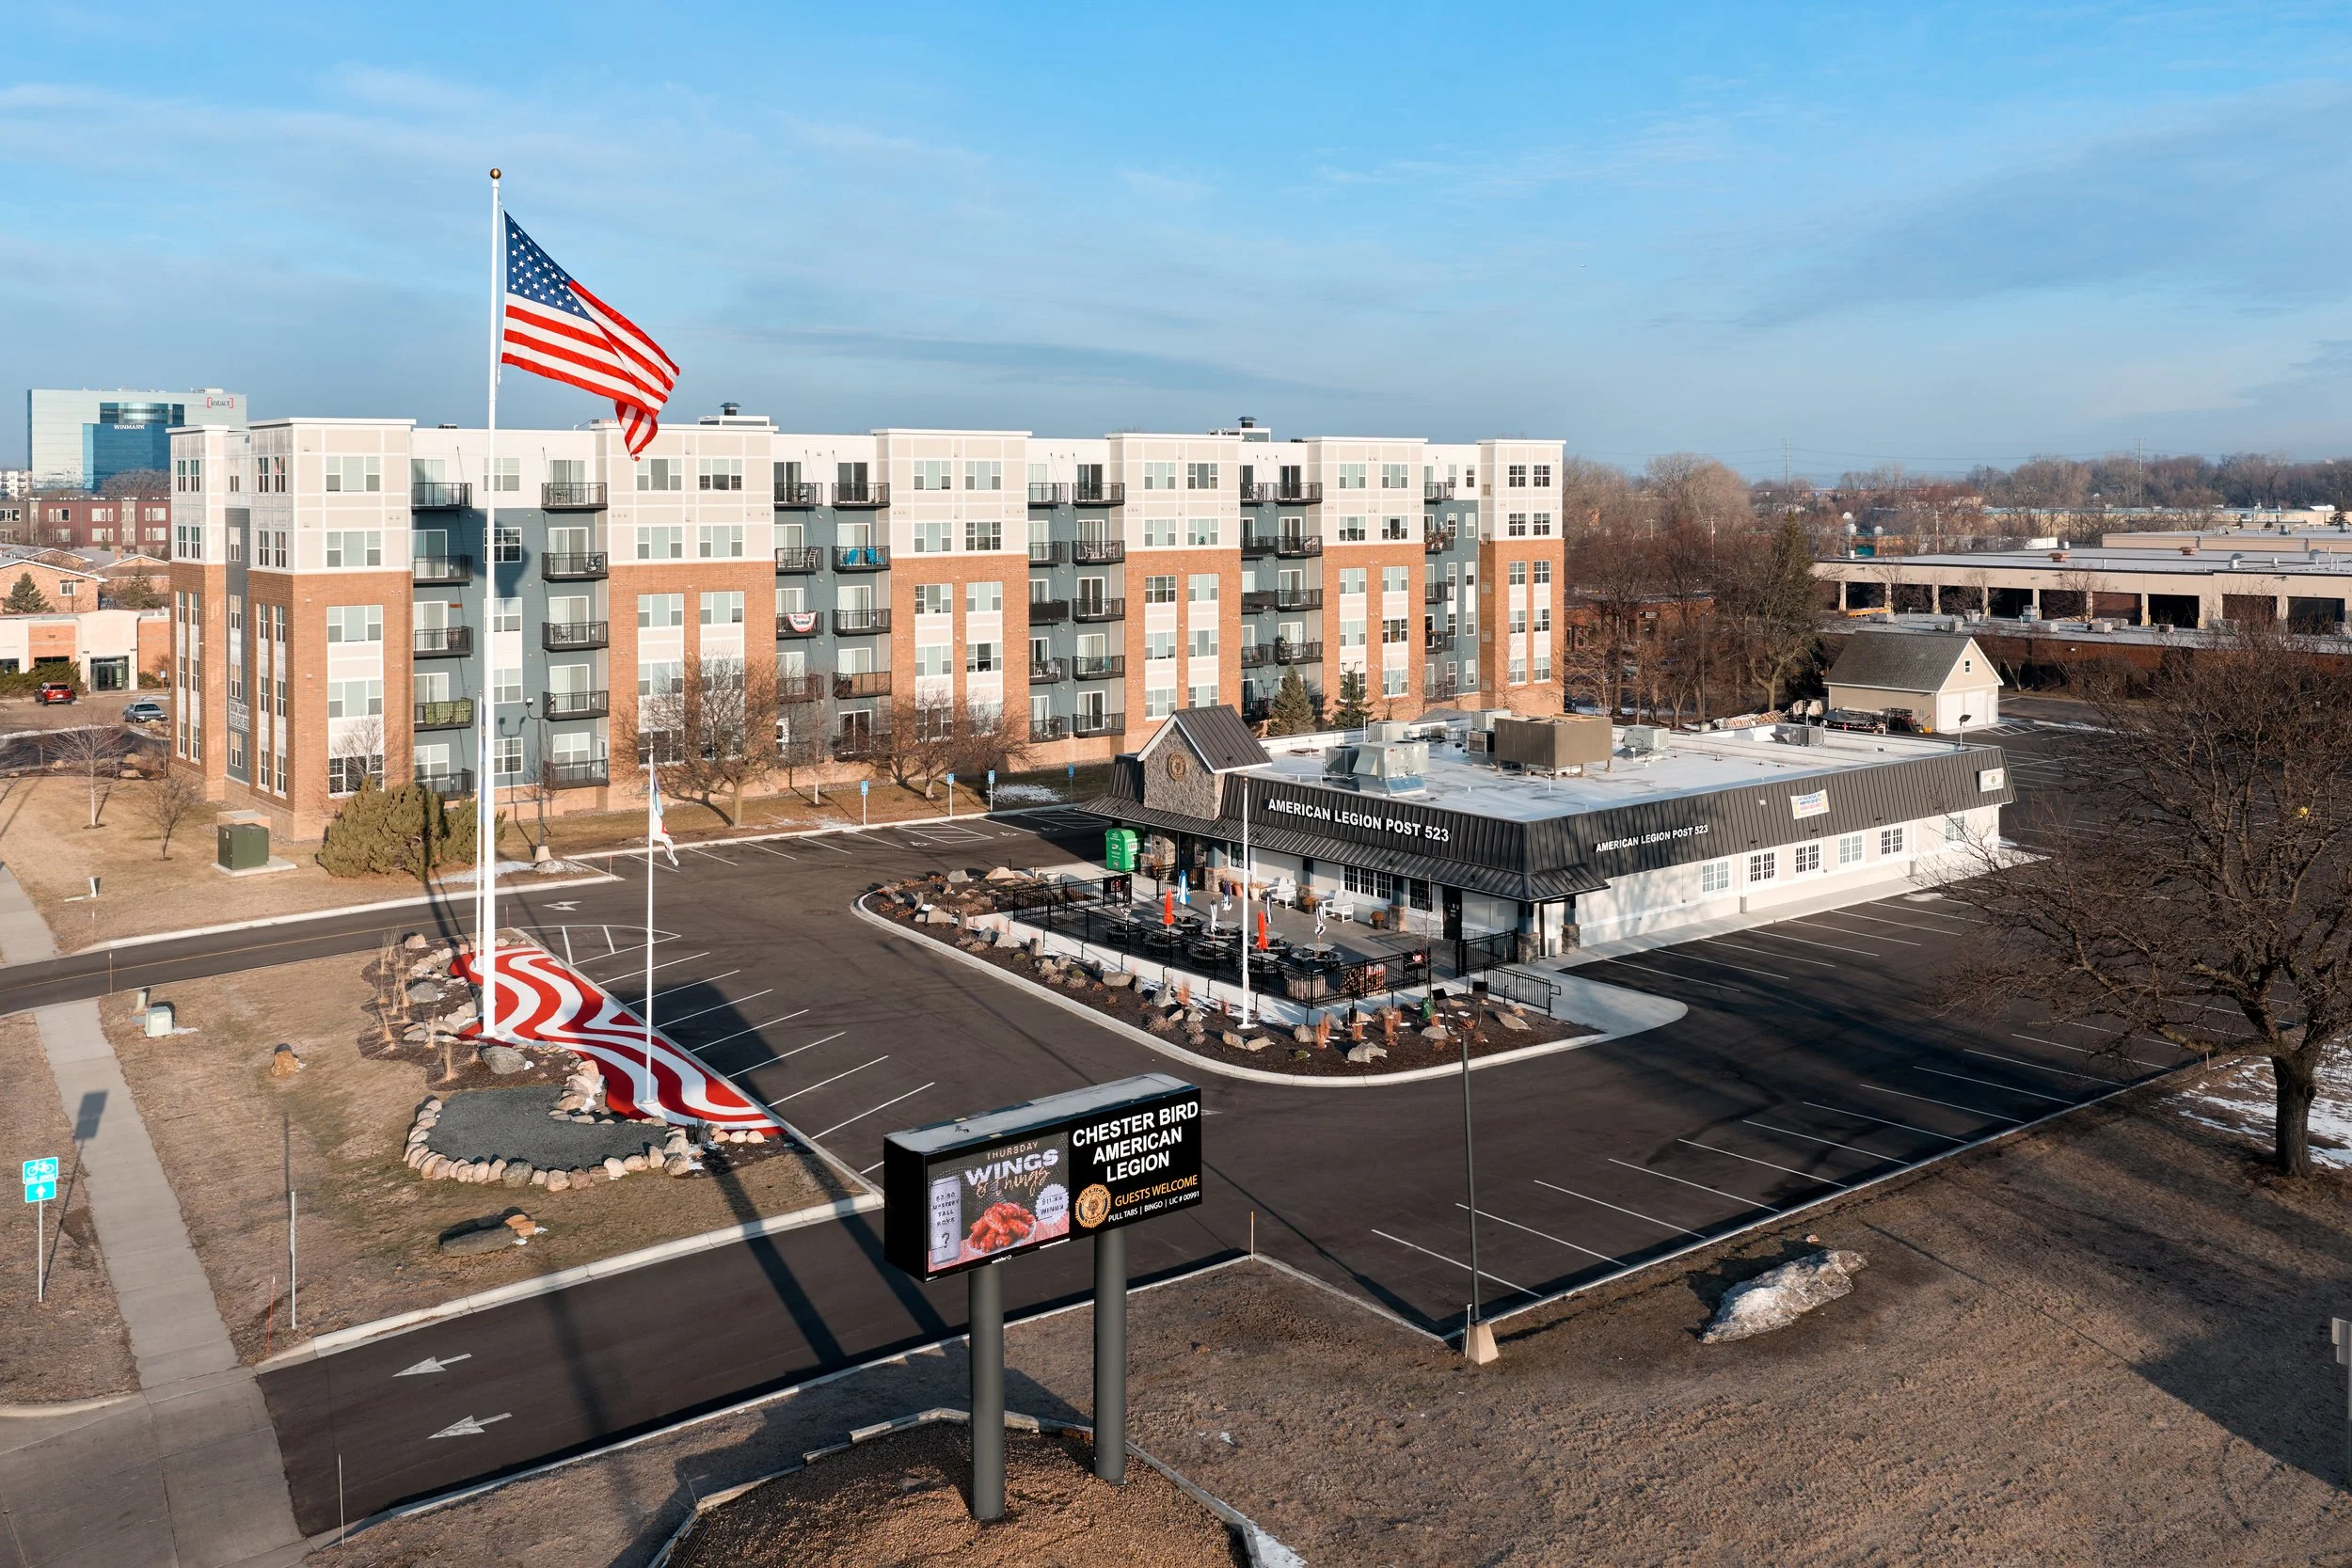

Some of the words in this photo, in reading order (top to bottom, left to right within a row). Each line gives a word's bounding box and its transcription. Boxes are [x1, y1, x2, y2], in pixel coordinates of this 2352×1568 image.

[1268, 799, 1331, 821] AMERICAN
[1334, 811, 1382, 831] LEGION
[1386, 818, 1422, 837] POST
[1424, 826, 1451, 842] 523
[1596, 836, 1639, 853] AMERICAN
[1641, 831, 1671, 845] LEGION
[1672, 827, 1693, 839] POST
[1694, 824, 1708, 835] 523
[1073, 1112, 1155, 1147] CHESTER
[1159, 1101, 1199, 1126] BIRD
[987, 1141, 1039, 1160] THURSDAY
[1092, 1126, 1183, 1165] AMERICAN
[965, 1148, 1058, 1185] WINGS
[1106, 1150, 1169, 1182] LEGION
[1108, 1212, 1123, 1222] PULL
[1123, 1207, 1138, 1218] TABS
[1144, 1200, 1163, 1212] BINGO
[1168, 1196, 1179, 1205] LIC
[1183, 1191, 1200, 1201] 00991
[1115, 1187, 1151, 1207] GUESTS
[1152, 1174, 1199, 1196] WELCOME
